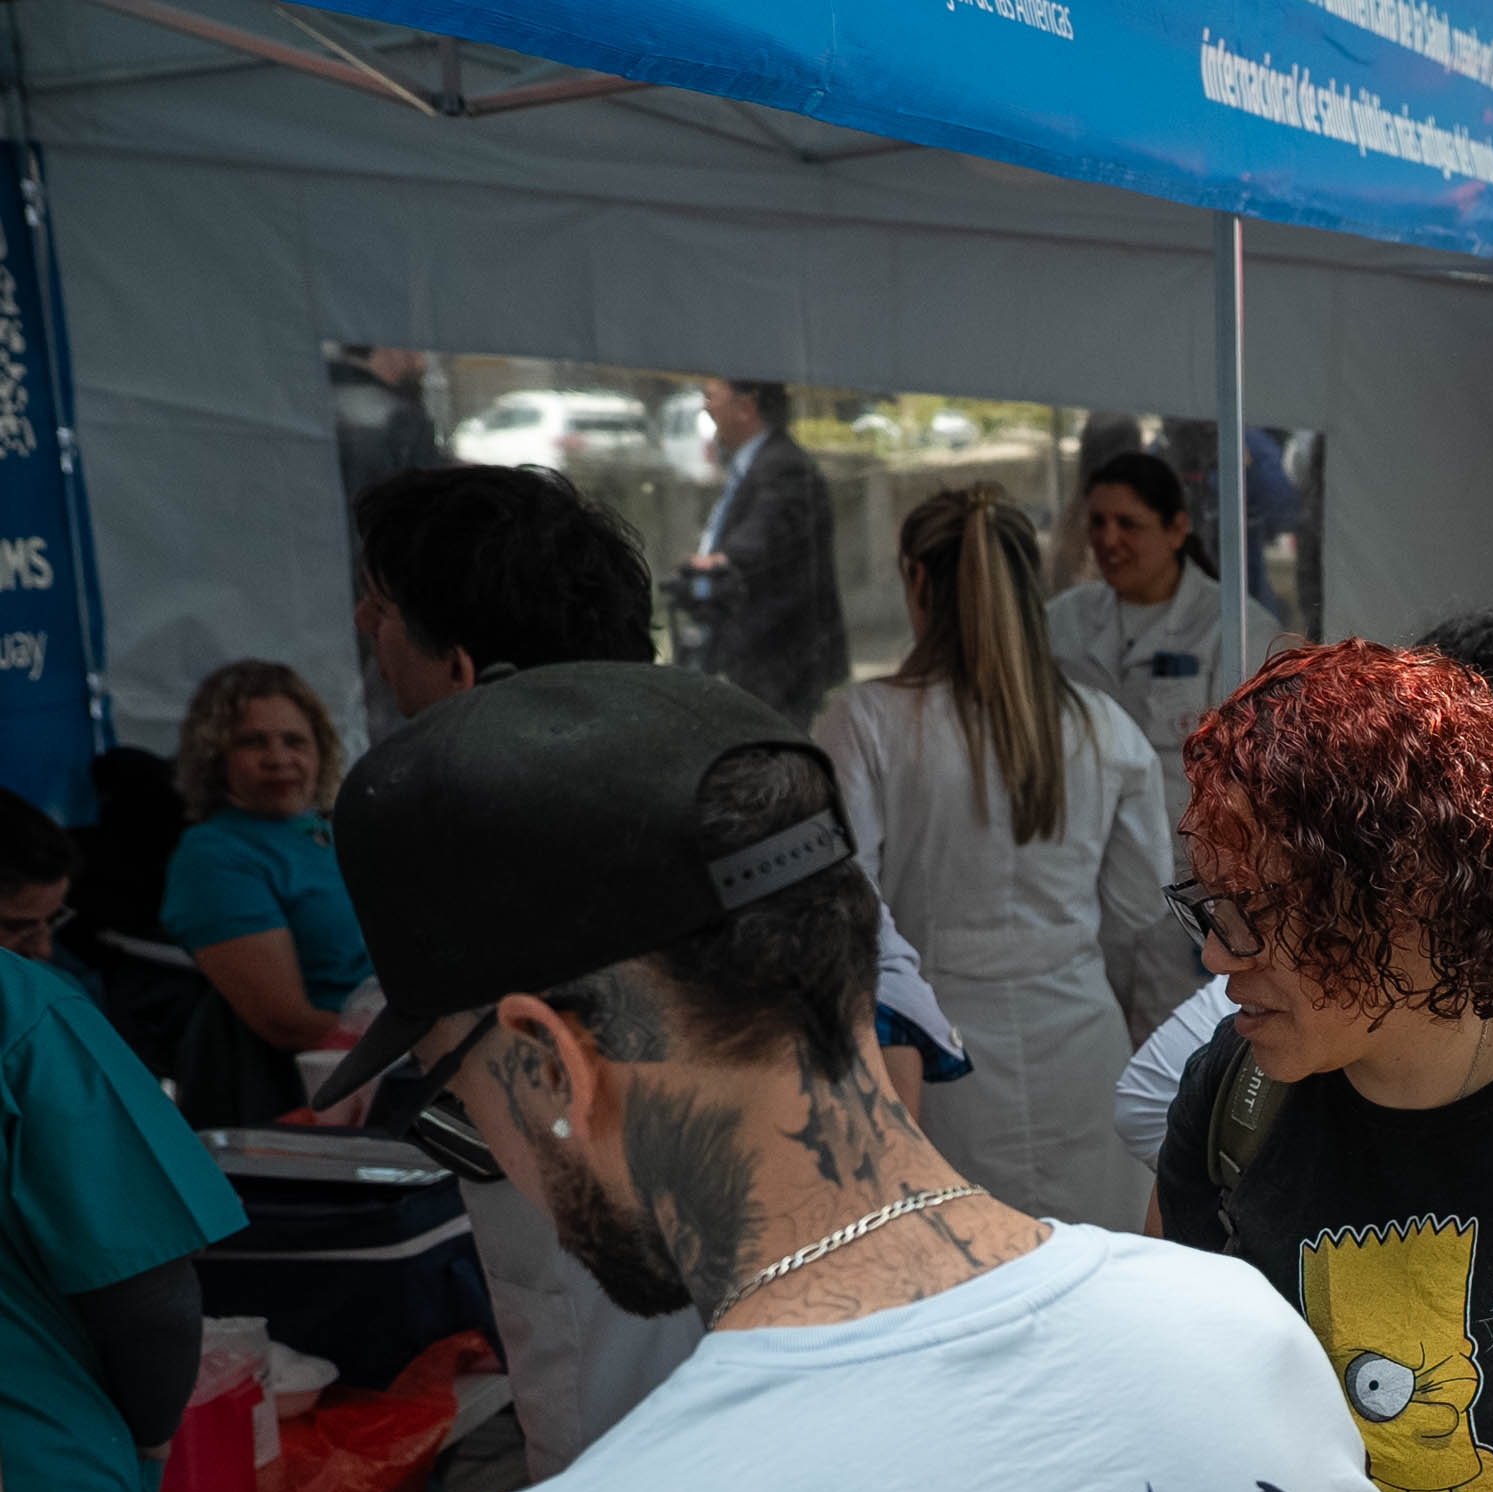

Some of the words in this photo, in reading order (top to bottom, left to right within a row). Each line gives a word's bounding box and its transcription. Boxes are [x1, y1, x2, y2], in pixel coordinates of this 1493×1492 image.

[1201, 27, 1304, 129] internacional
[1300, 67, 1323, 135] de
[1317, 78, 1359, 146] salud
[0, 536, 54, 590] MS
